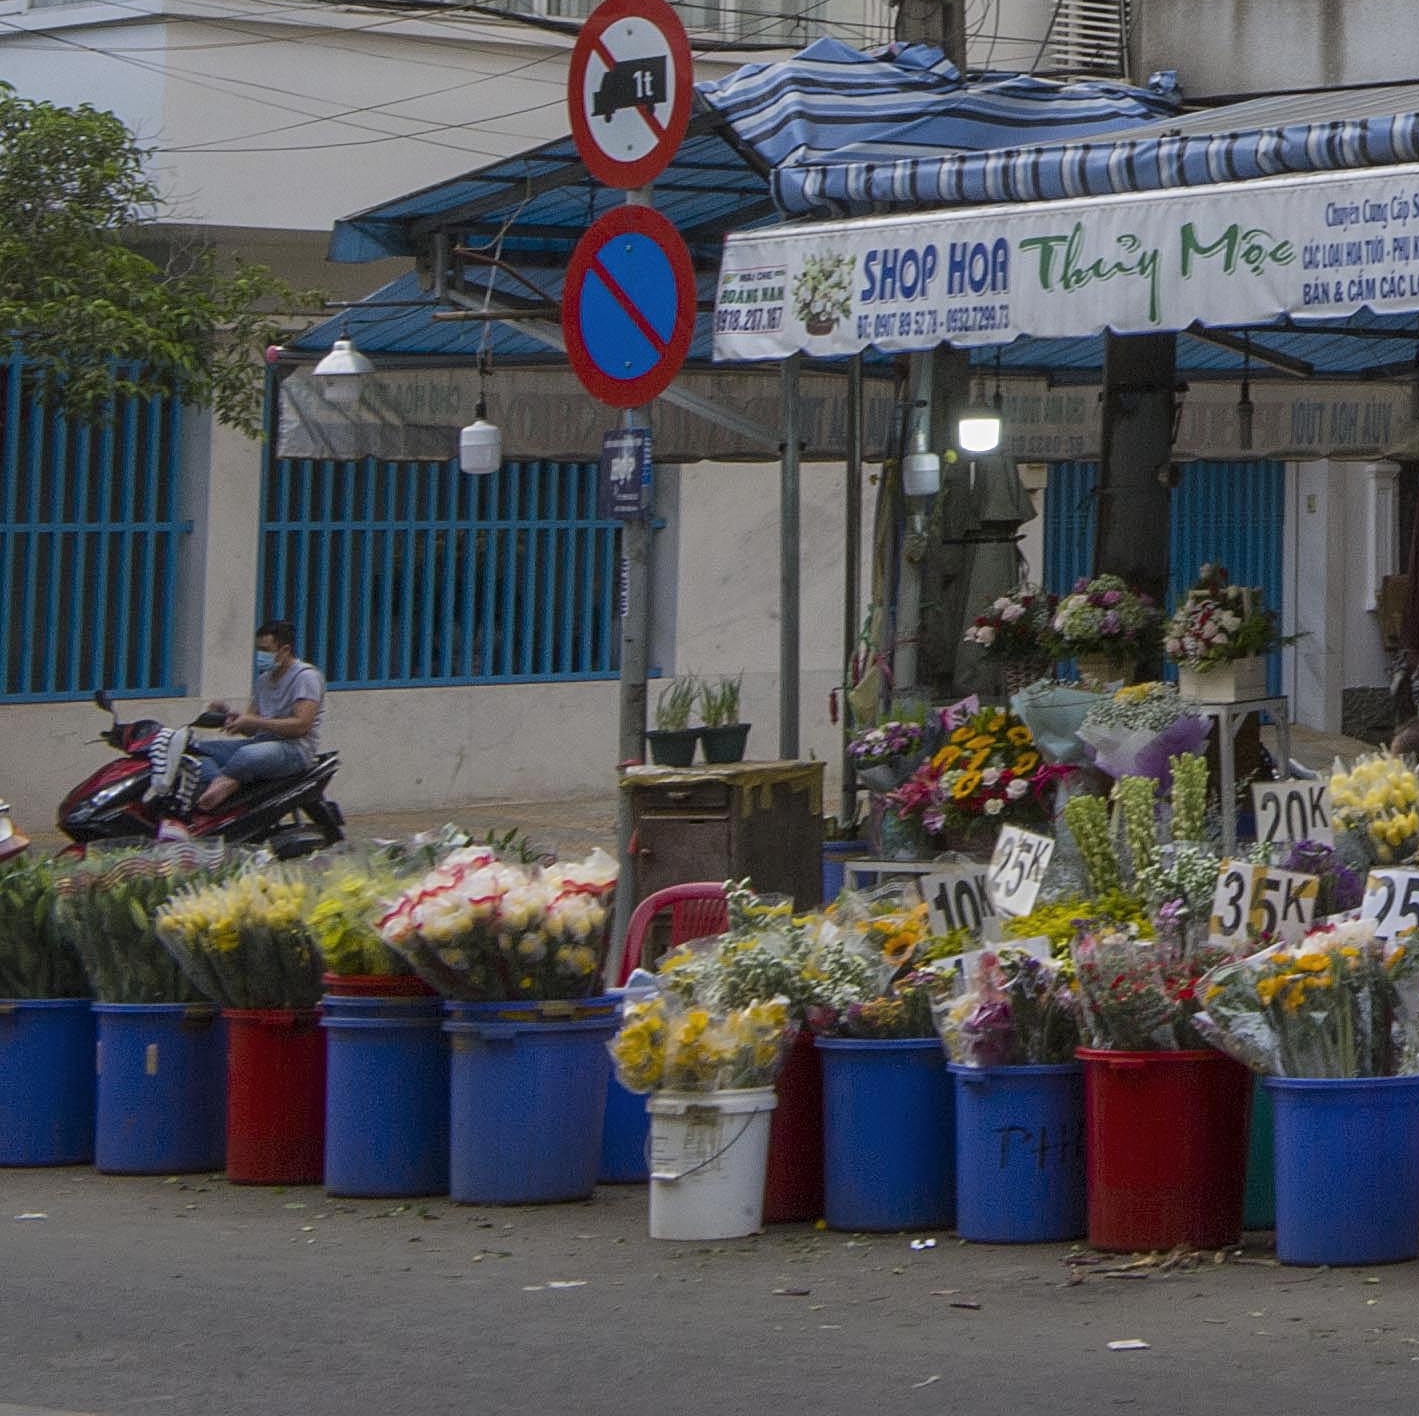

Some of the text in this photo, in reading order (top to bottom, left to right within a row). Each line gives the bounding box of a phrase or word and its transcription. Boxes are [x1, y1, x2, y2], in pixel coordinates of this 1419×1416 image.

[860, 237, 1010, 304] SHOP HOA
[1019, 222, 1296, 325] Thủy Mộc
[1304, 275, 1329, 305] BÁN
[1334, 283, 1344, 304] &
[1380, 268, 1406, 299] CÁC
[1261, 787, 1329, 844] 20K
[993, 835, 1050, 898] 25K
[934, 874, 996, 934] 10K
[1220, 872, 1312, 937] 35K
